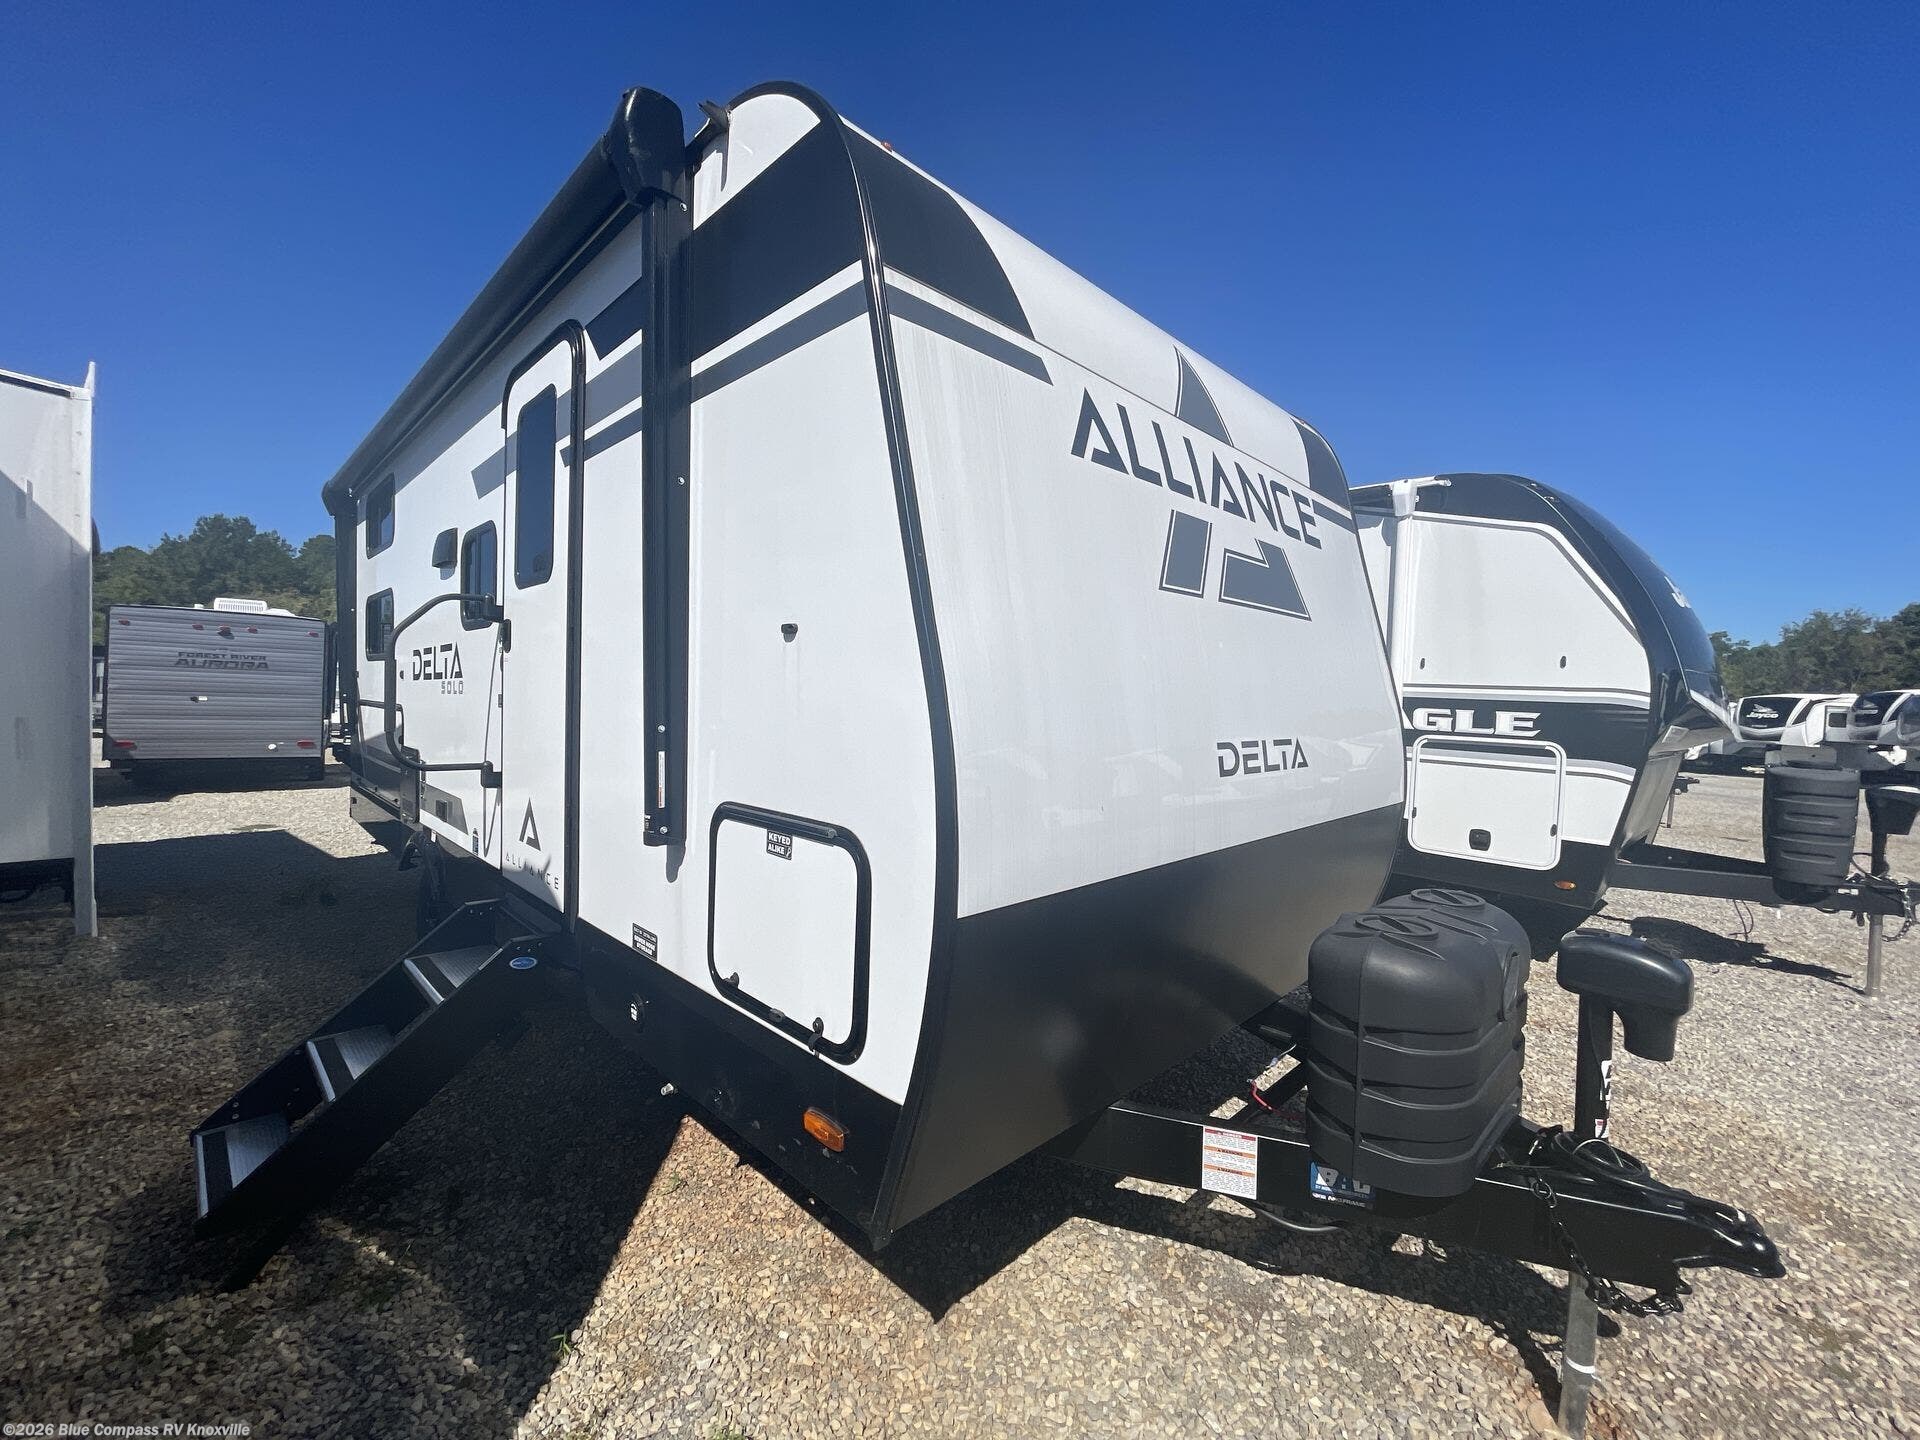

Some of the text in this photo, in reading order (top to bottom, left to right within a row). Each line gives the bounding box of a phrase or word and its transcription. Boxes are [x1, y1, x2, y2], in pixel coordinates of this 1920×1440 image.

[1071, 387, 1322, 549] ALLIANCE
[178, 651, 226, 660] FOREST
[412, 641, 463, 680] DELTA
[174, 658, 269, 670] AURORA
[441, 680, 464, 695] SOLO
[1746, 711, 1779, 719] Jayco
[1216, 737, 1309, 778] DELTA
[768, 832, 791, 845] KEYED
[767, 843, 785, 855] ALIKE
